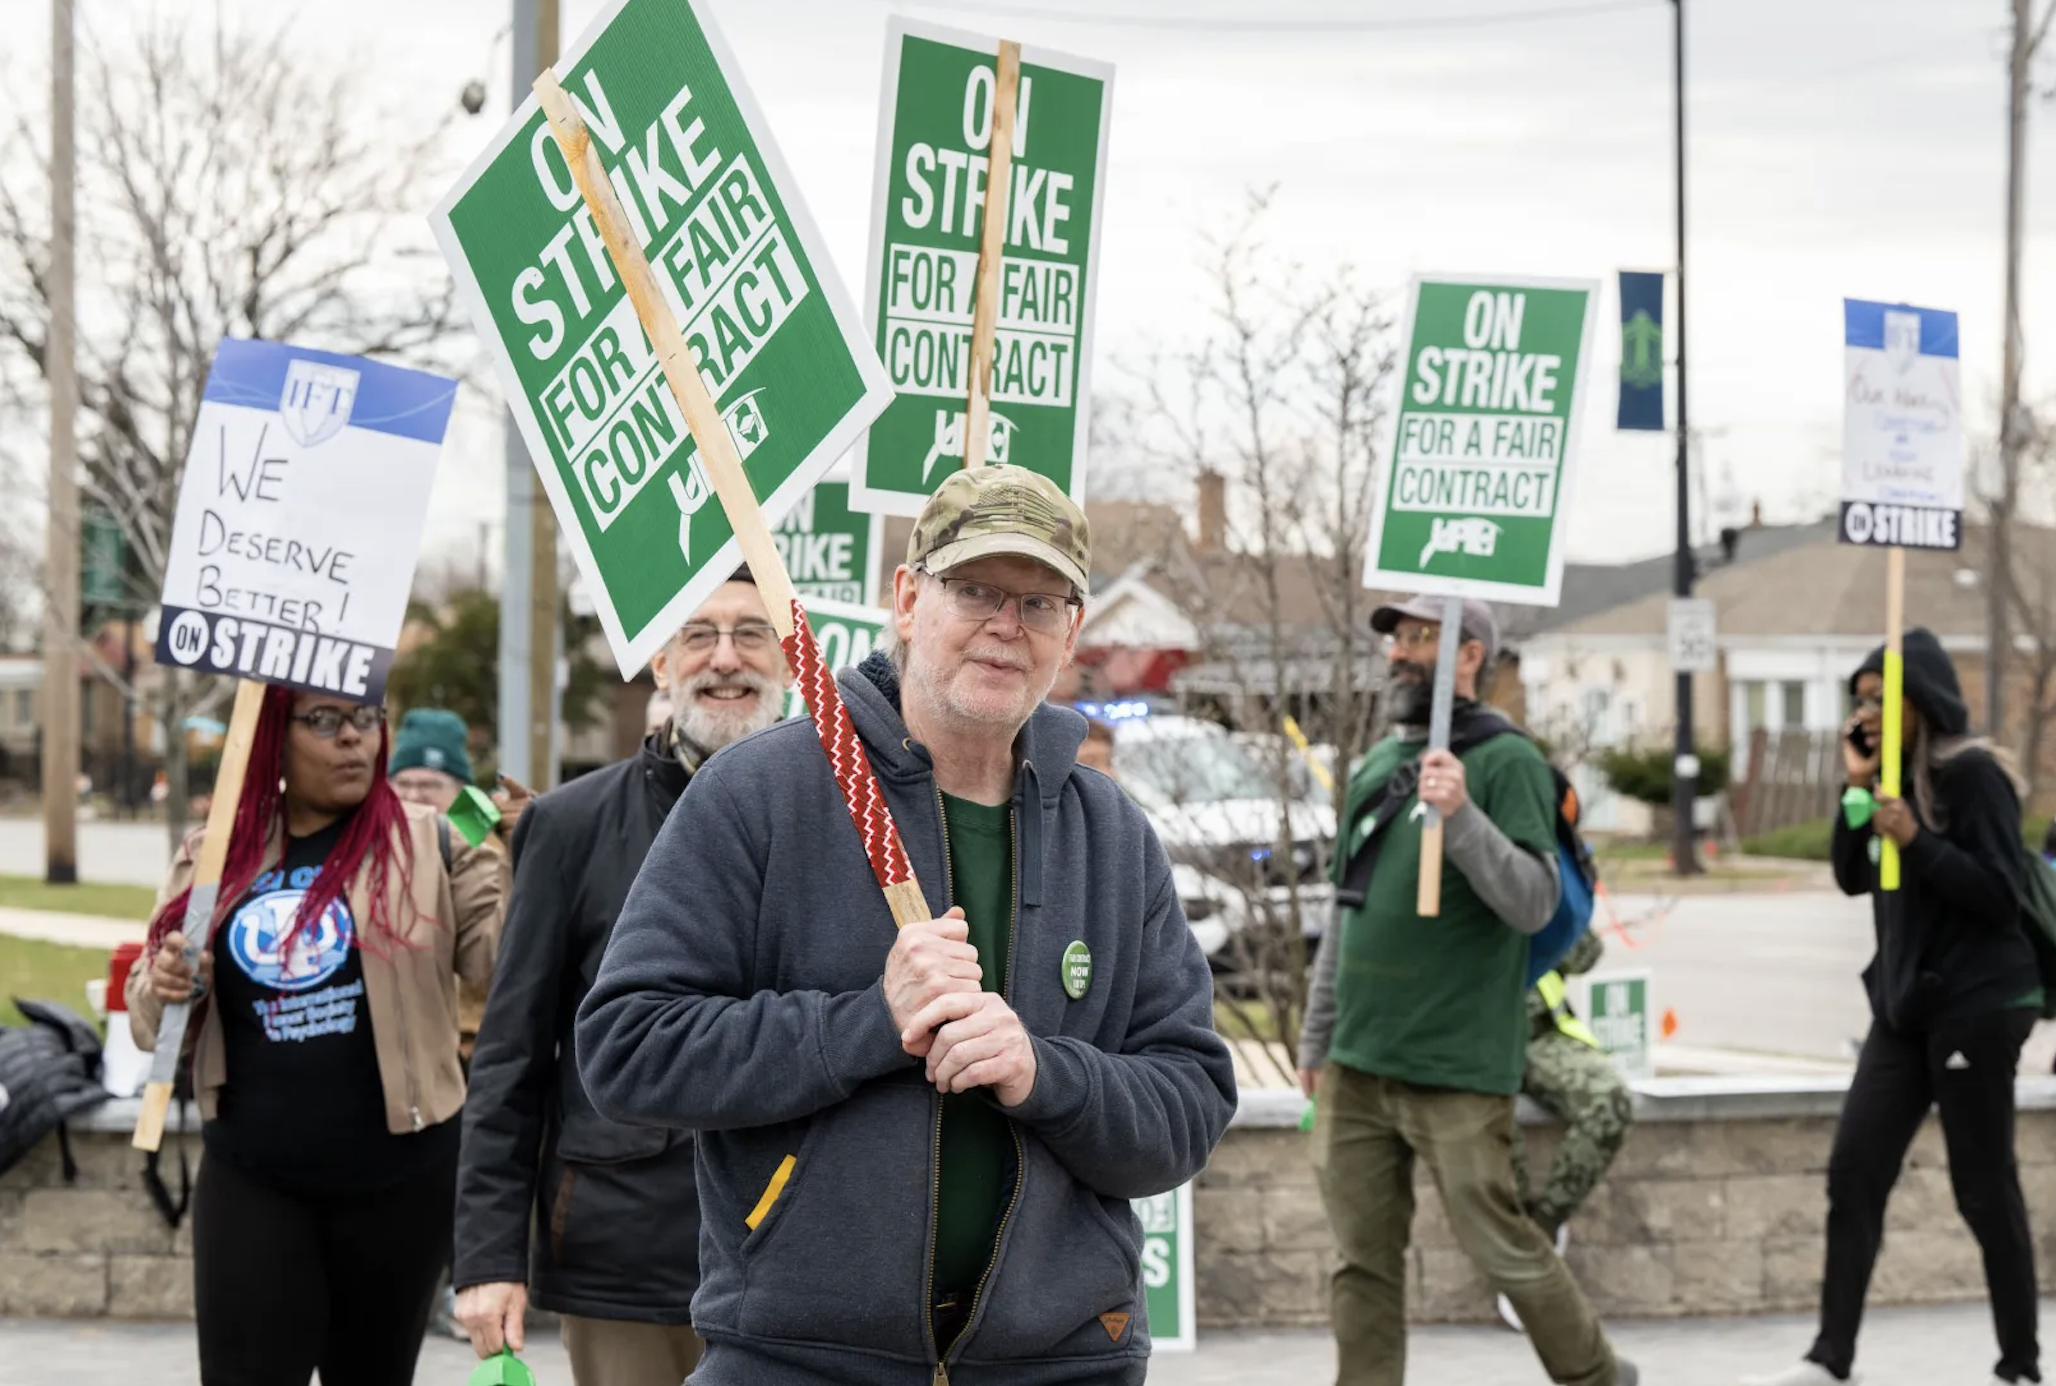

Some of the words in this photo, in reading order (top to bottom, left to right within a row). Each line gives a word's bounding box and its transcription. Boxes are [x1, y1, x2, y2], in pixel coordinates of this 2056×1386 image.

[531, 68, 626, 212] ON
[544, 326, 637, 451] FOR
[662, 169, 767, 310] FAIR
[891, 249, 956, 312] FOR
[1002, 263, 1073, 325] FAIR
[1463, 290, 1526, 351] ON
[1412, 345, 1561, 413] STRIKE
[1402, 418, 1455, 455] FOR
[1463, 420, 1482, 456] A
[1493, 421, 1556, 459] FAIR
[1400, 467, 1549, 510] CONTRACT
[1873, 504, 1957, 548] STRIKE
[176, 624, 203, 652] ON
[210, 617, 375, 697] STRIKE
[1071, 966, 1089, 977] NOW
